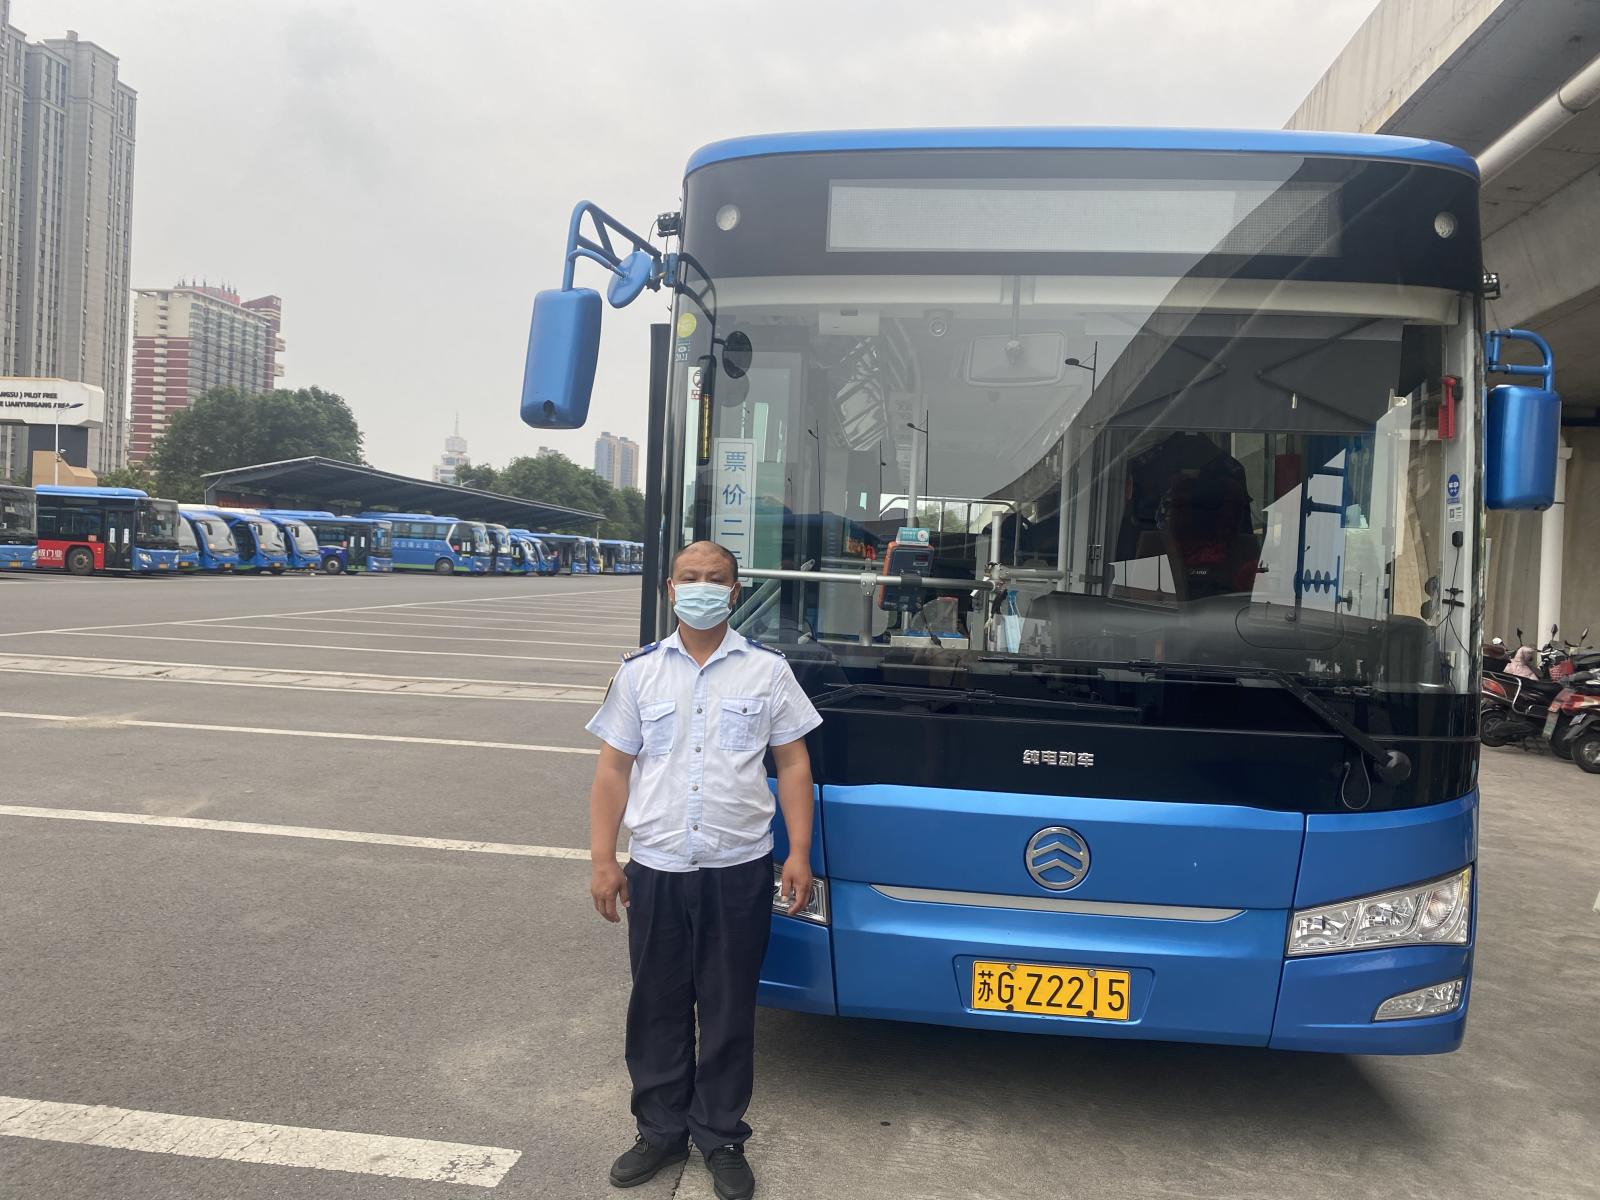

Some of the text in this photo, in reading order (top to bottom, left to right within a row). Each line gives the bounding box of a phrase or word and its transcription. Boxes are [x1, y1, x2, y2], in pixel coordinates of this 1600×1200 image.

[675, 353, 688, 361] 2021
[1023, 750, 1094, 767] 纯电动车
